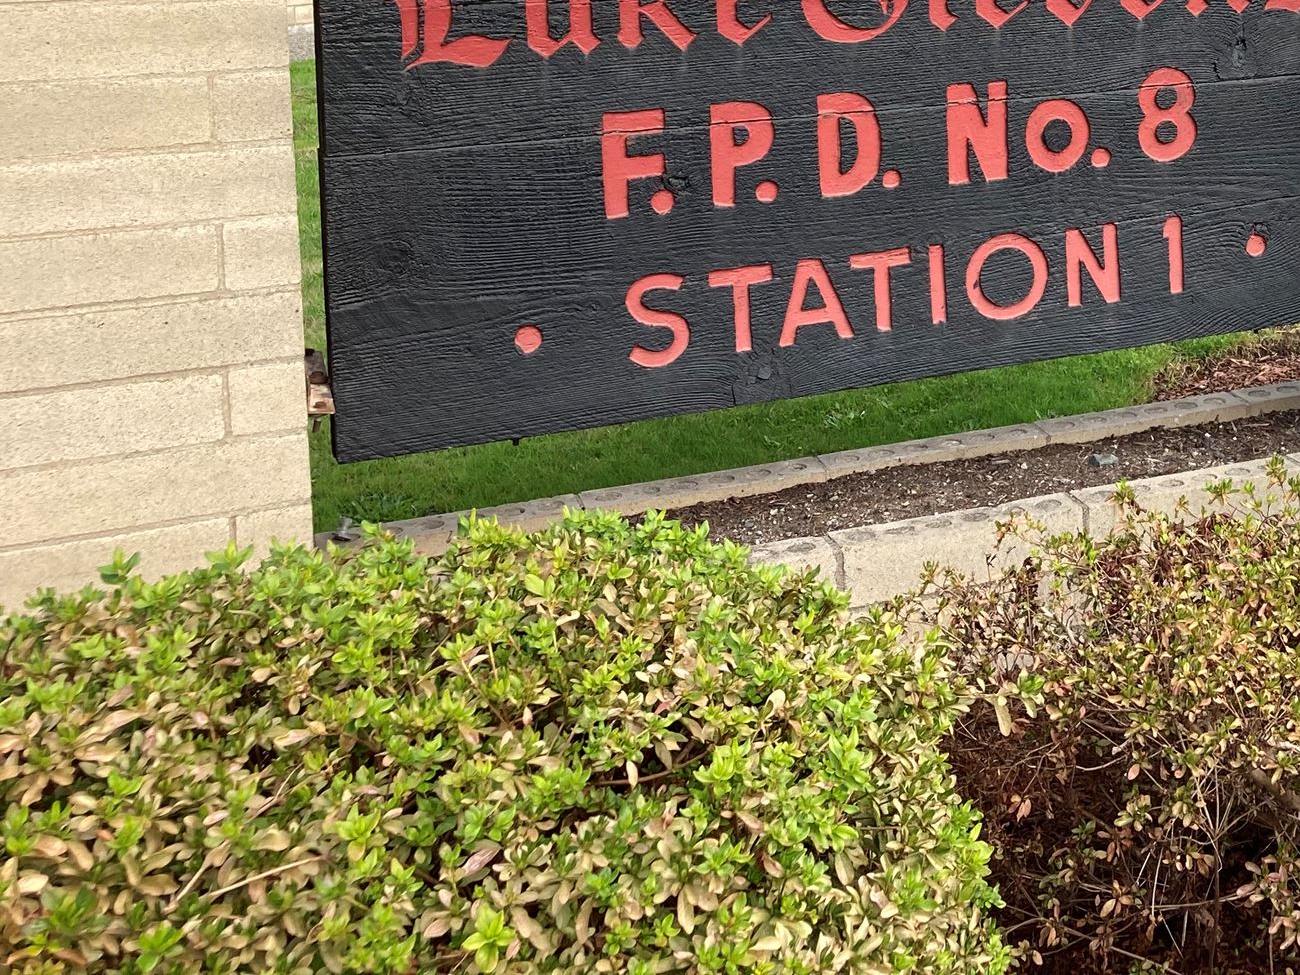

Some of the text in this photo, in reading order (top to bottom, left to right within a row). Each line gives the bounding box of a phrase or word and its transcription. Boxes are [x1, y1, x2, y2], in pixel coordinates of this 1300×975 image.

[945, 79, 1112, 185] No.
[1136, 66, 1197, 163] 8
[624, 215, 1184, 368] STATION 1
